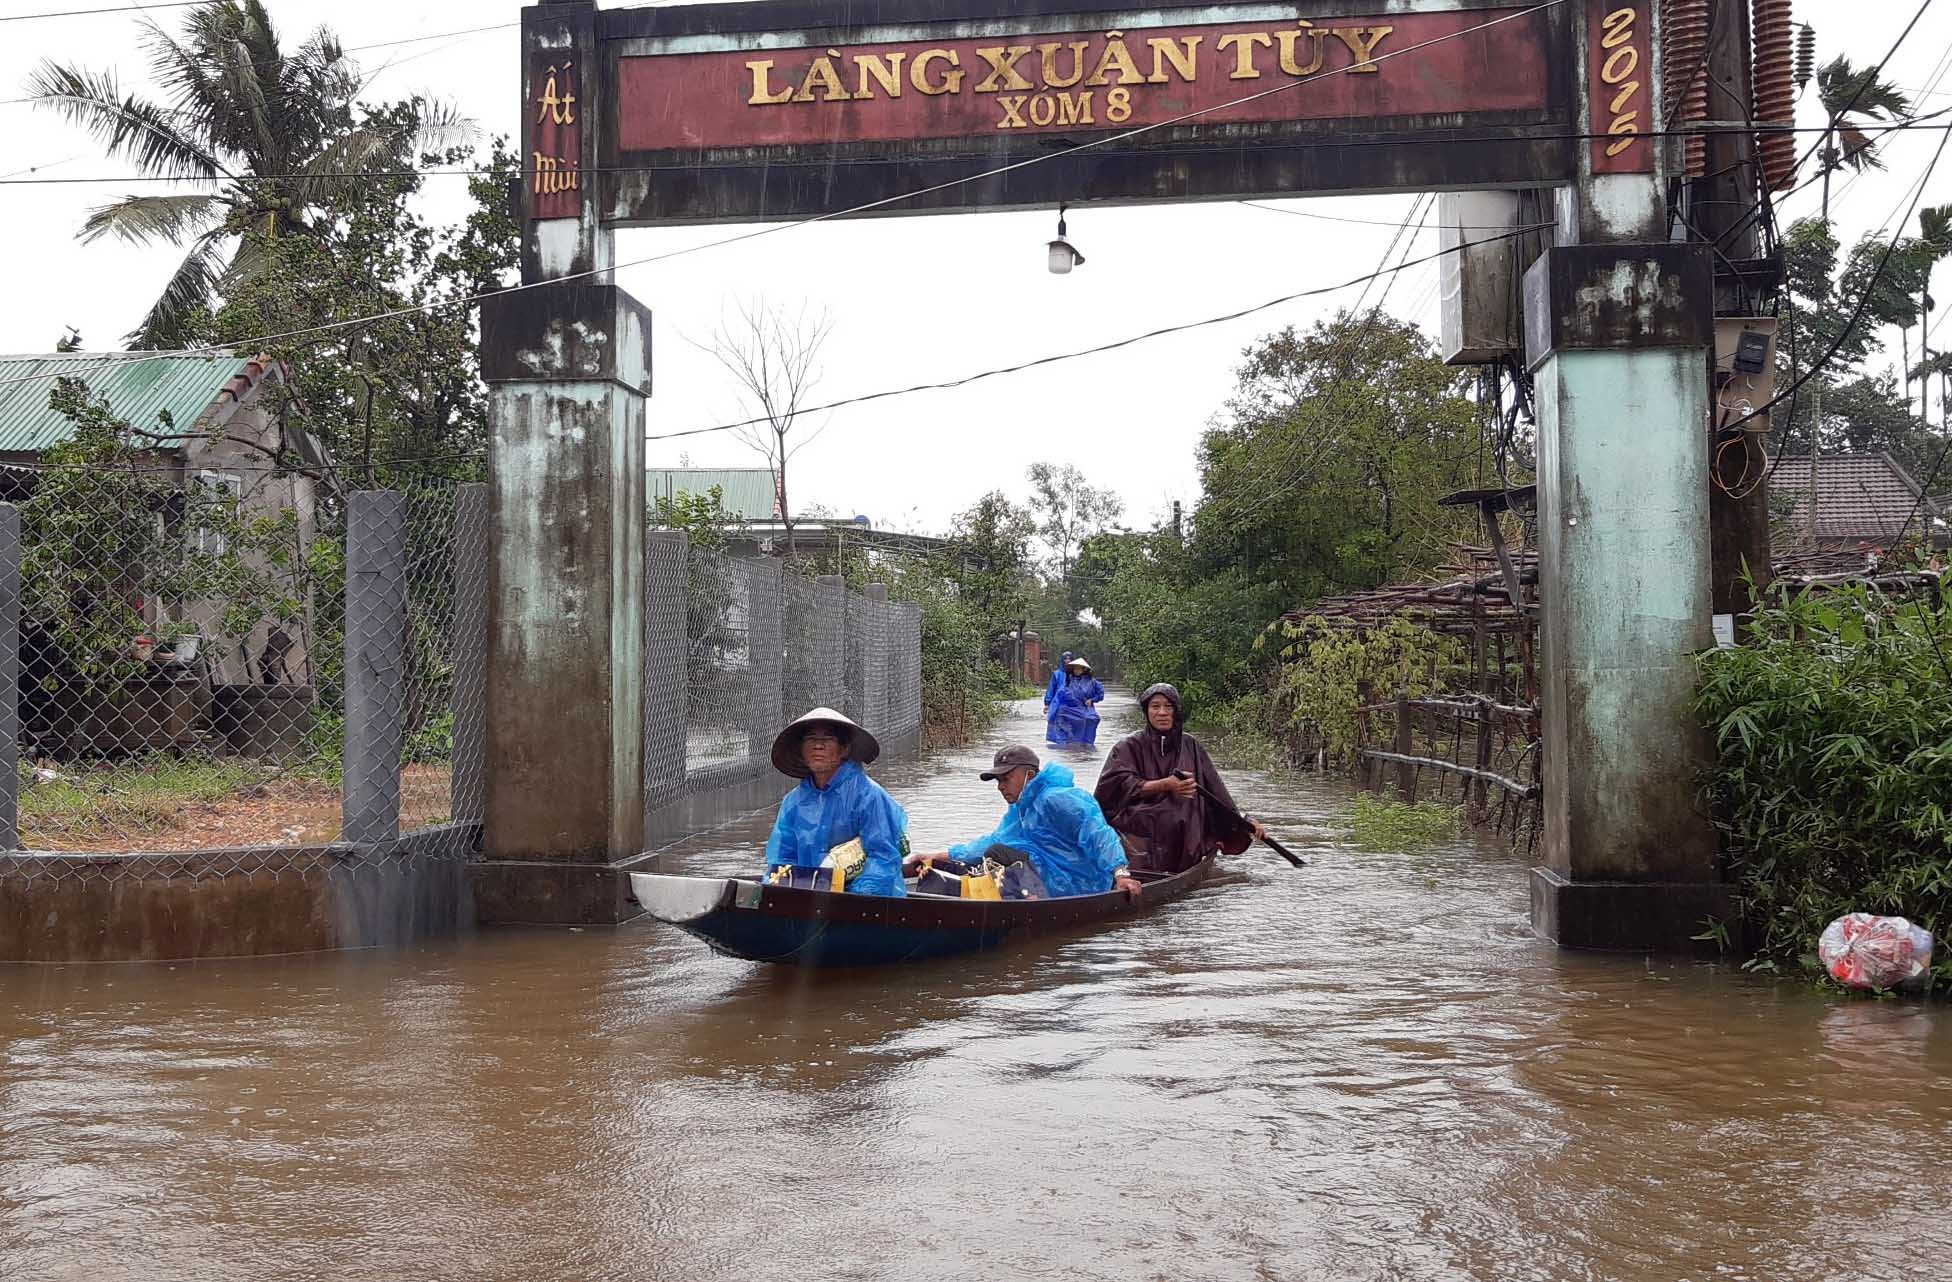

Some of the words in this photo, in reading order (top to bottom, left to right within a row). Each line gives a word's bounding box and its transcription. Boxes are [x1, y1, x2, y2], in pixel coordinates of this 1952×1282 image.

[537, 60, 576, 125] Ất
[745, 48, 966, 105] LÀNG
[974, 30, 1204, 93] XUÂN
[1216, 20, 1393, 80] TÙY
[1601, 7, 1639, 157] 2015
[996, 85, 1095, 129] XÓM
[1106, 87, 1133, 123] 8
[532, 151, 579, 195] Mùi
